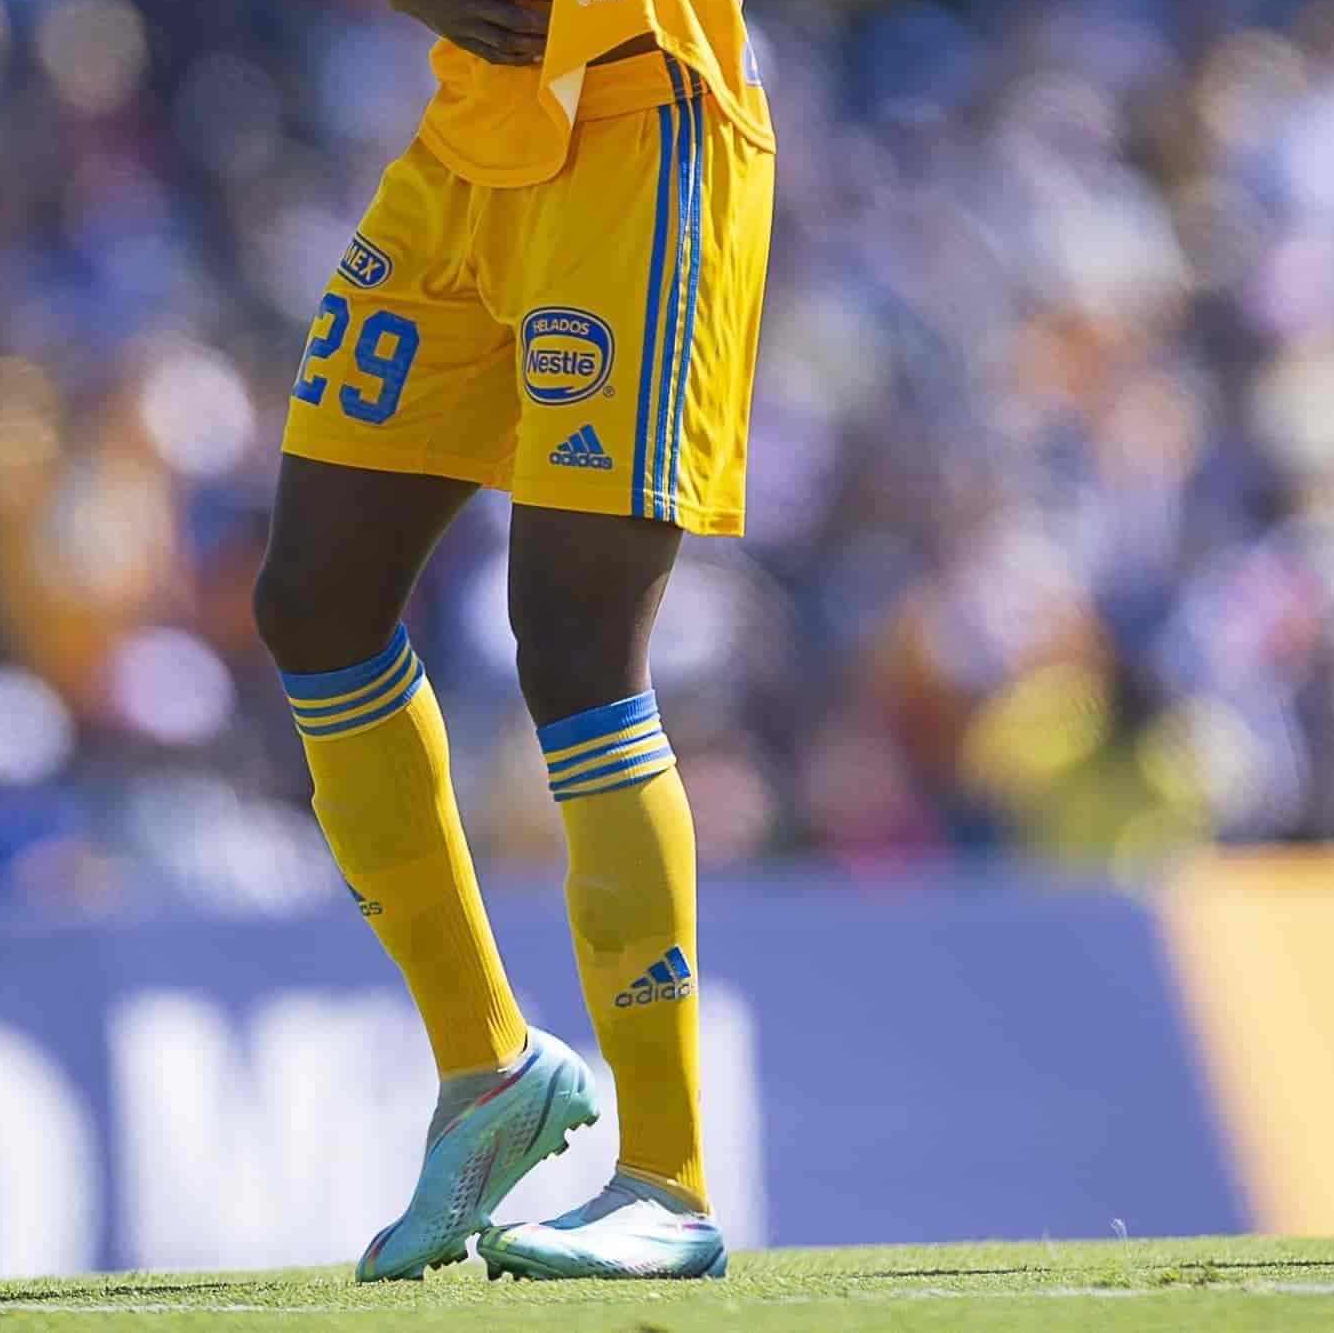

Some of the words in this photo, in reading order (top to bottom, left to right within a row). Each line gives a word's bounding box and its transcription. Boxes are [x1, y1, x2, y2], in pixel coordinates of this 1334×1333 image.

[341, 238, 381, 282] MEX
[533, 318, 590, 335] HELADOS
[292, 292, 420, 426] 29
[549, 450, 613, 470] adidas
[614, 978, 694, 1008] adida
